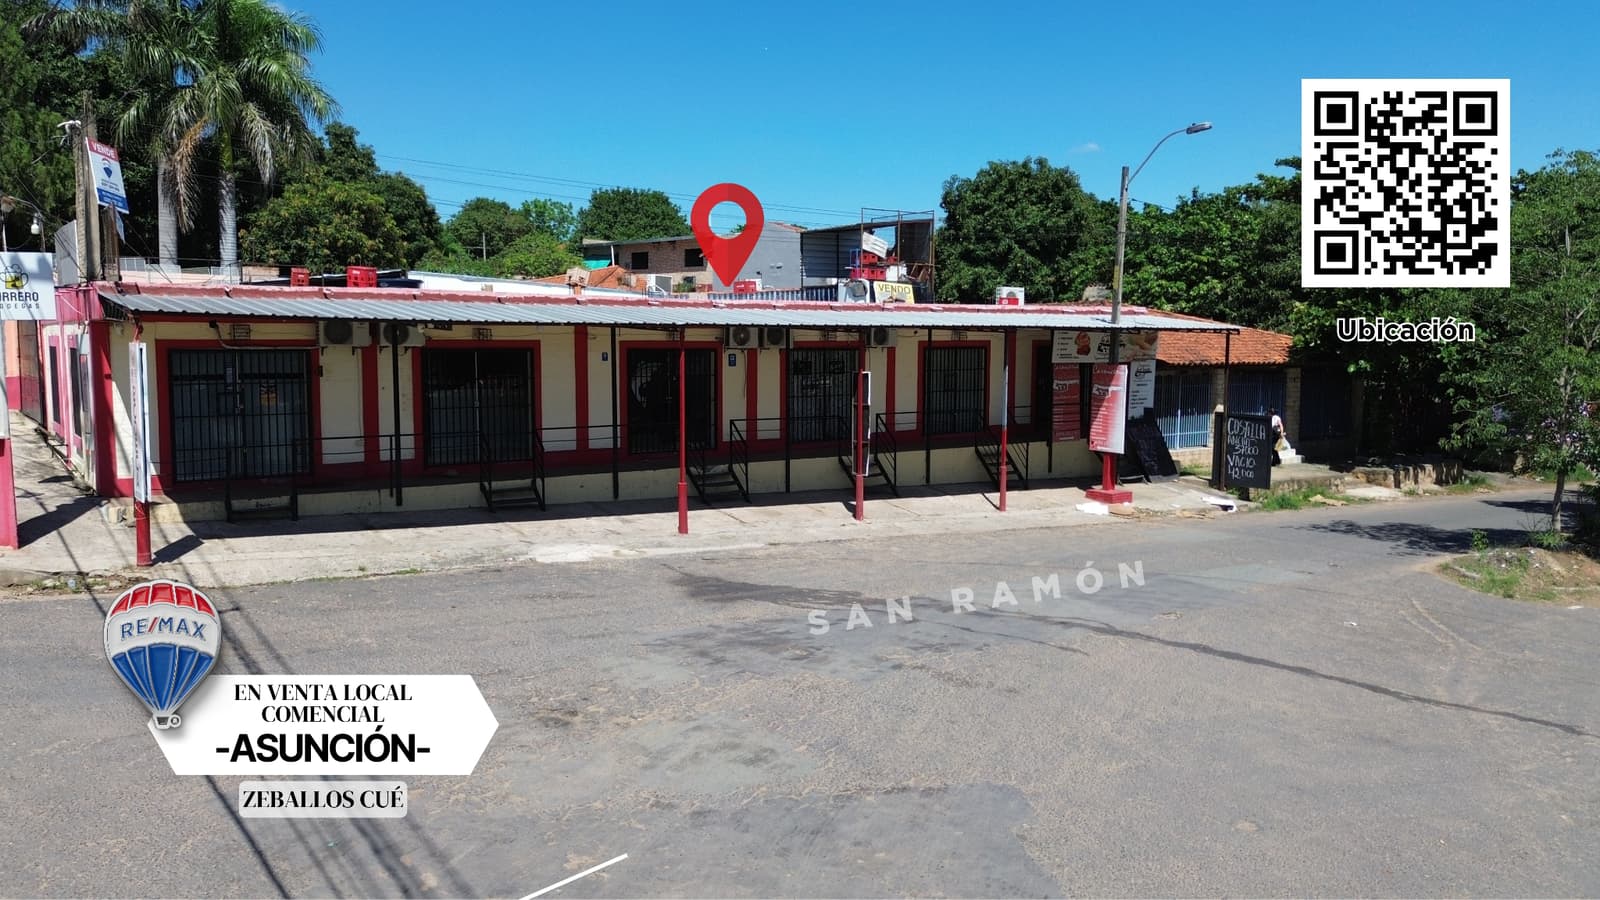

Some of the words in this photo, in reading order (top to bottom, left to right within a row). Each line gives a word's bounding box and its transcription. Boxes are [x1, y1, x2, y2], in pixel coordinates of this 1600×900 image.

[91, 141, 116, 159] VENDE
[878, 283, 911, 294] VENDO
[0, 291, 39, 302] RRERO
[1227, 417, 1266, 441] COSTILLA
[1227, 454, 1257, 469] VACIO
